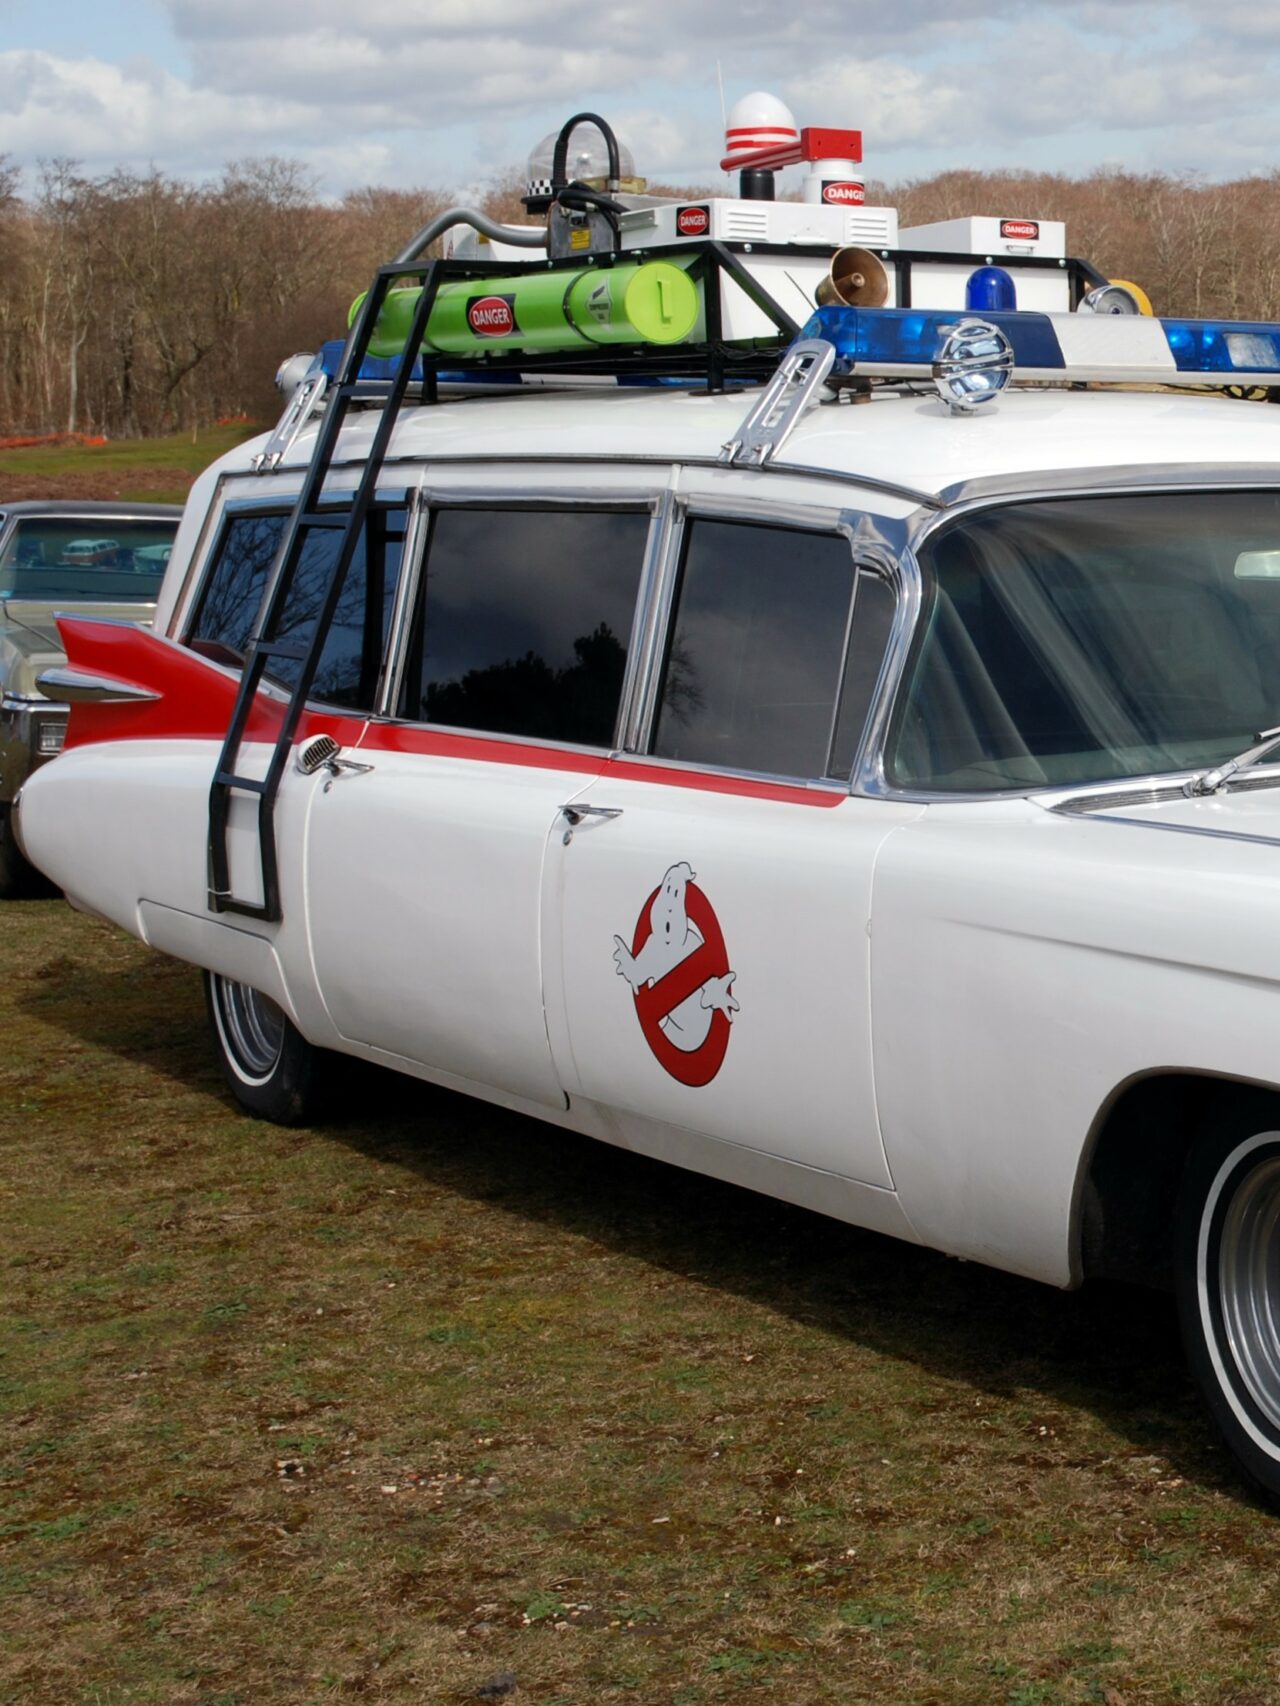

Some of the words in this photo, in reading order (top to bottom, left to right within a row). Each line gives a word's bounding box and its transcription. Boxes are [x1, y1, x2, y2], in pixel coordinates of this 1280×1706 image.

[828, 188, 864, 201] DANGE
[681, 215, 705, 226] DANGER
[1005, 225, 1035, 235] DANGER
[472, 308, 510, 326] DANGER
